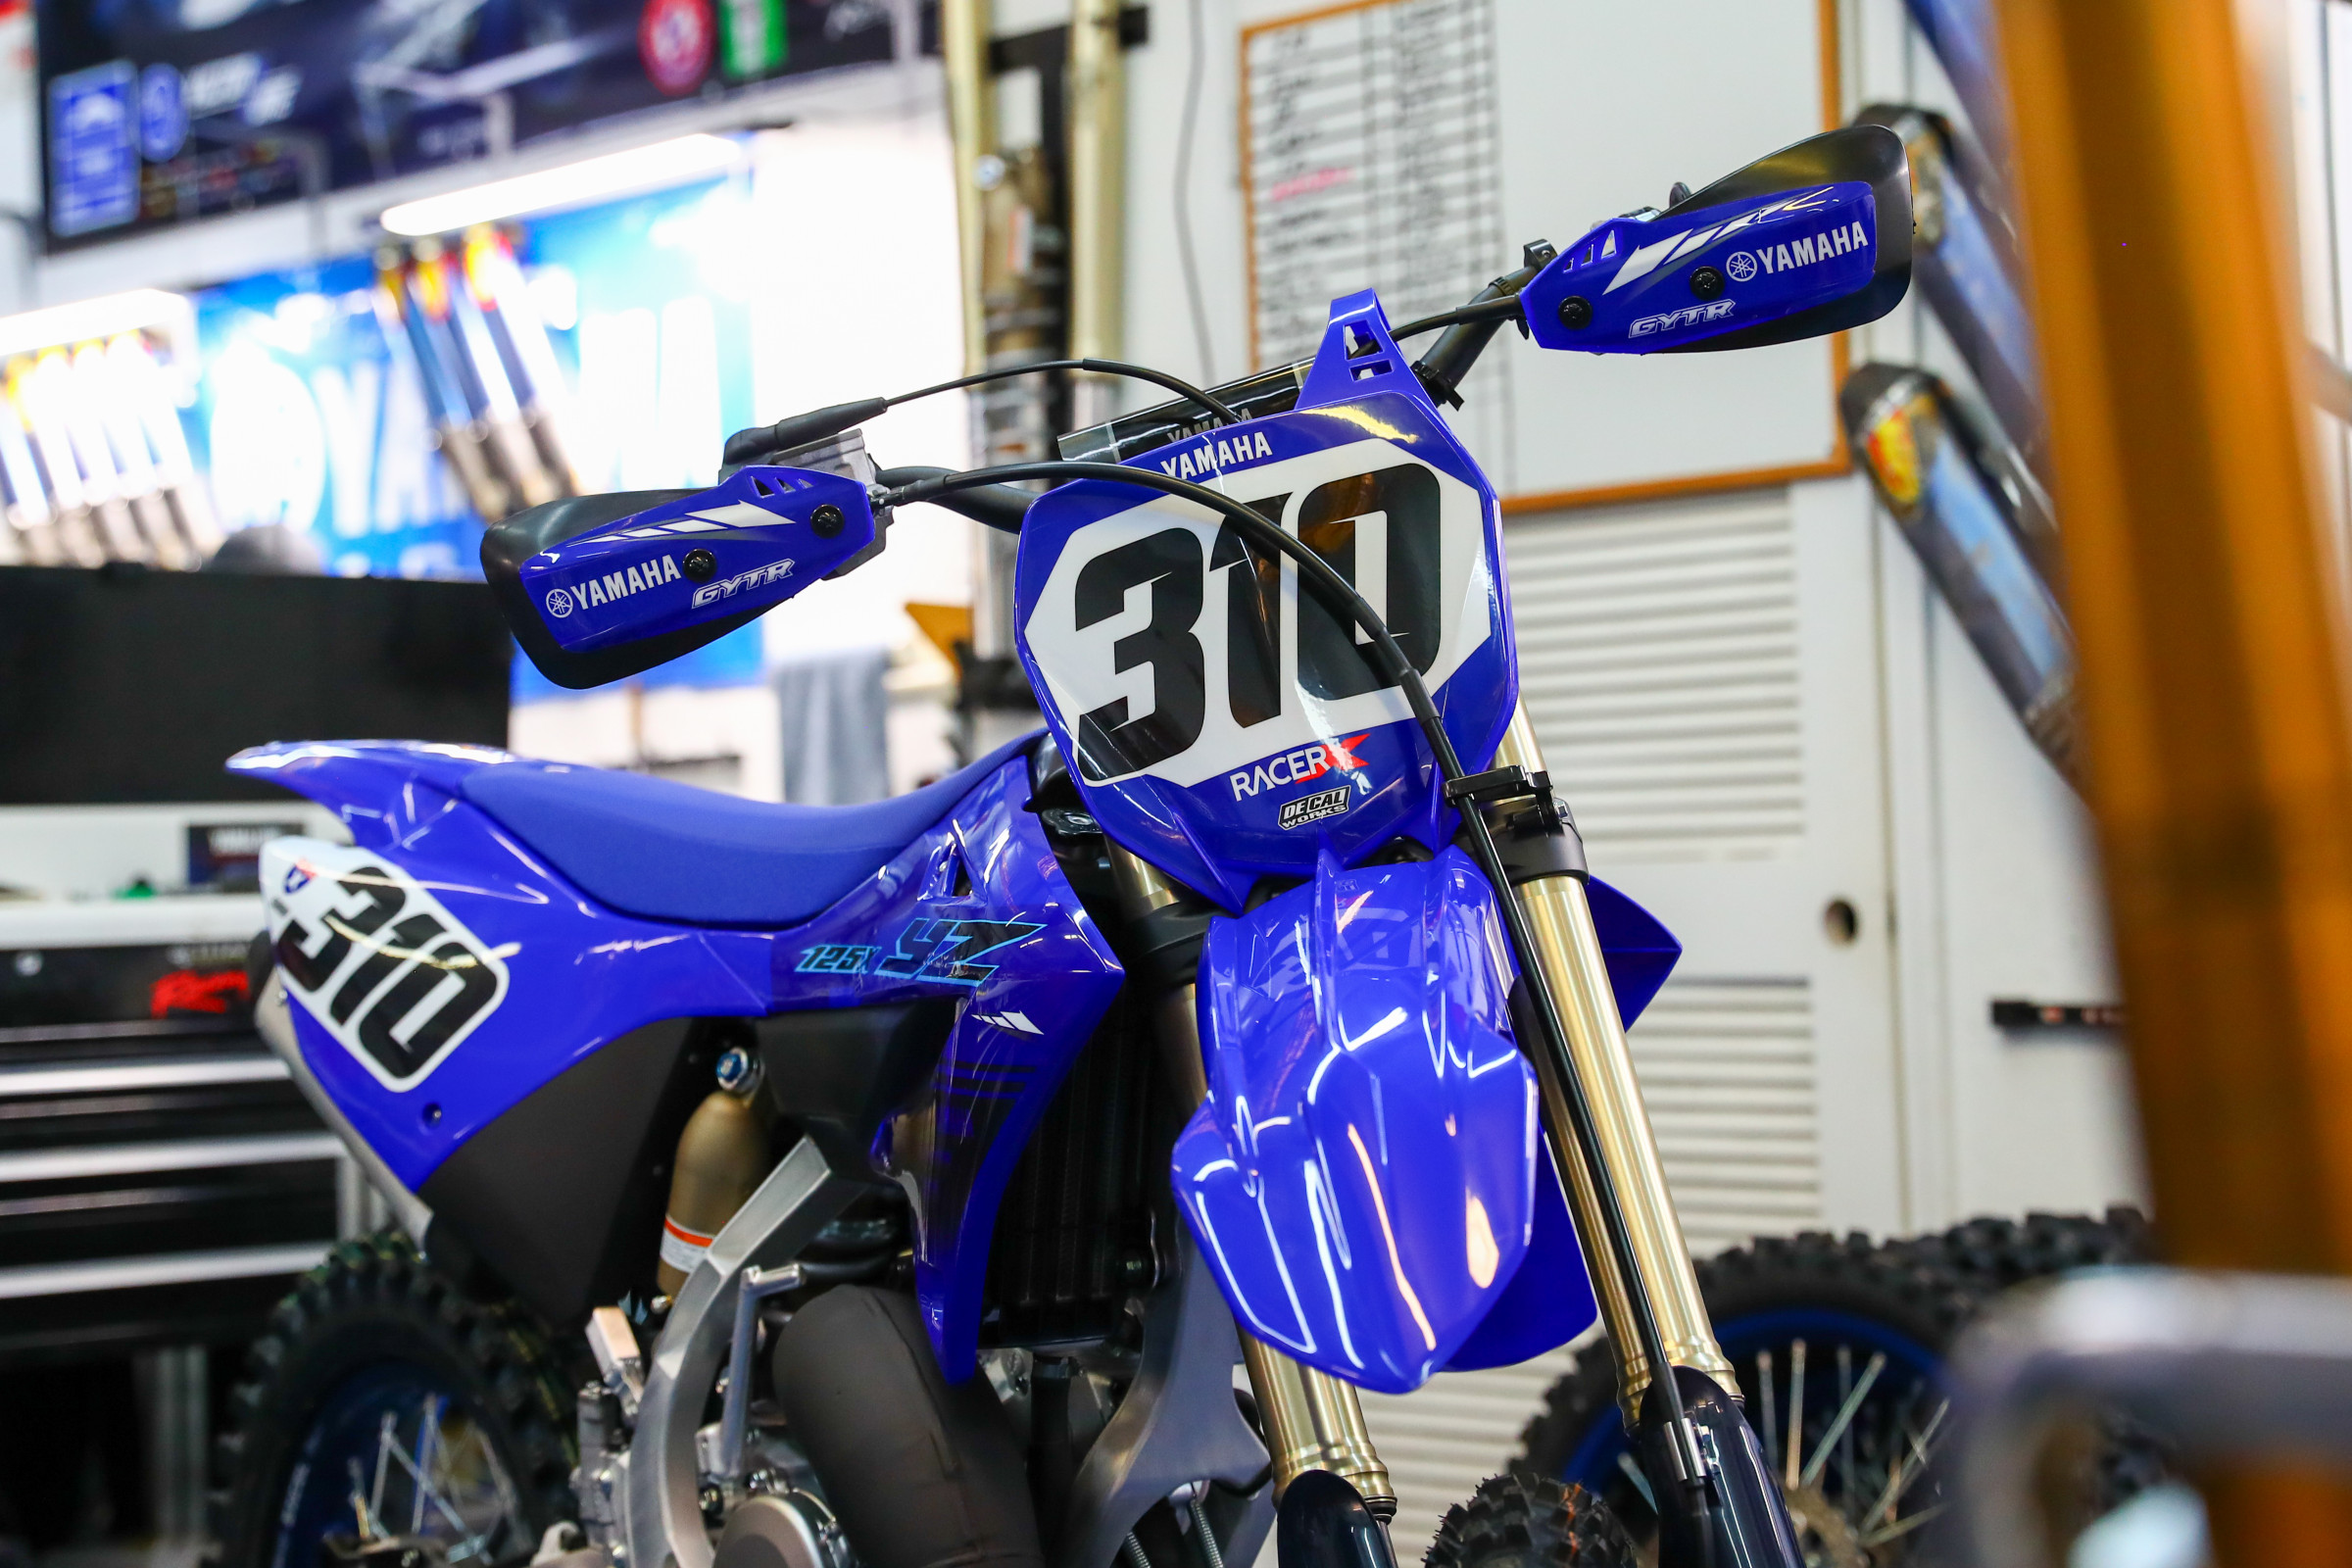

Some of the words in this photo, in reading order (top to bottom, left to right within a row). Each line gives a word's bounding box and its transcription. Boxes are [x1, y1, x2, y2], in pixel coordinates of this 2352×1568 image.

[1756, 220, 1870, 274] YAMAHA
[1628, 299, 1737, 339] GYTR
[1160, 431, 1273, 480] YAMAHA
[570, 554, 682, 611] YAMAHA
[692, 558, 796, 610] GYTR
[1074, 462, 1442, 782] 310
[1282, 805, 1348, 829] WORKS
[1283, 787, 1347, 820] DECAL
[276, 866, 498, 1079] 310
[874, 917, 1049, 988] YZ
